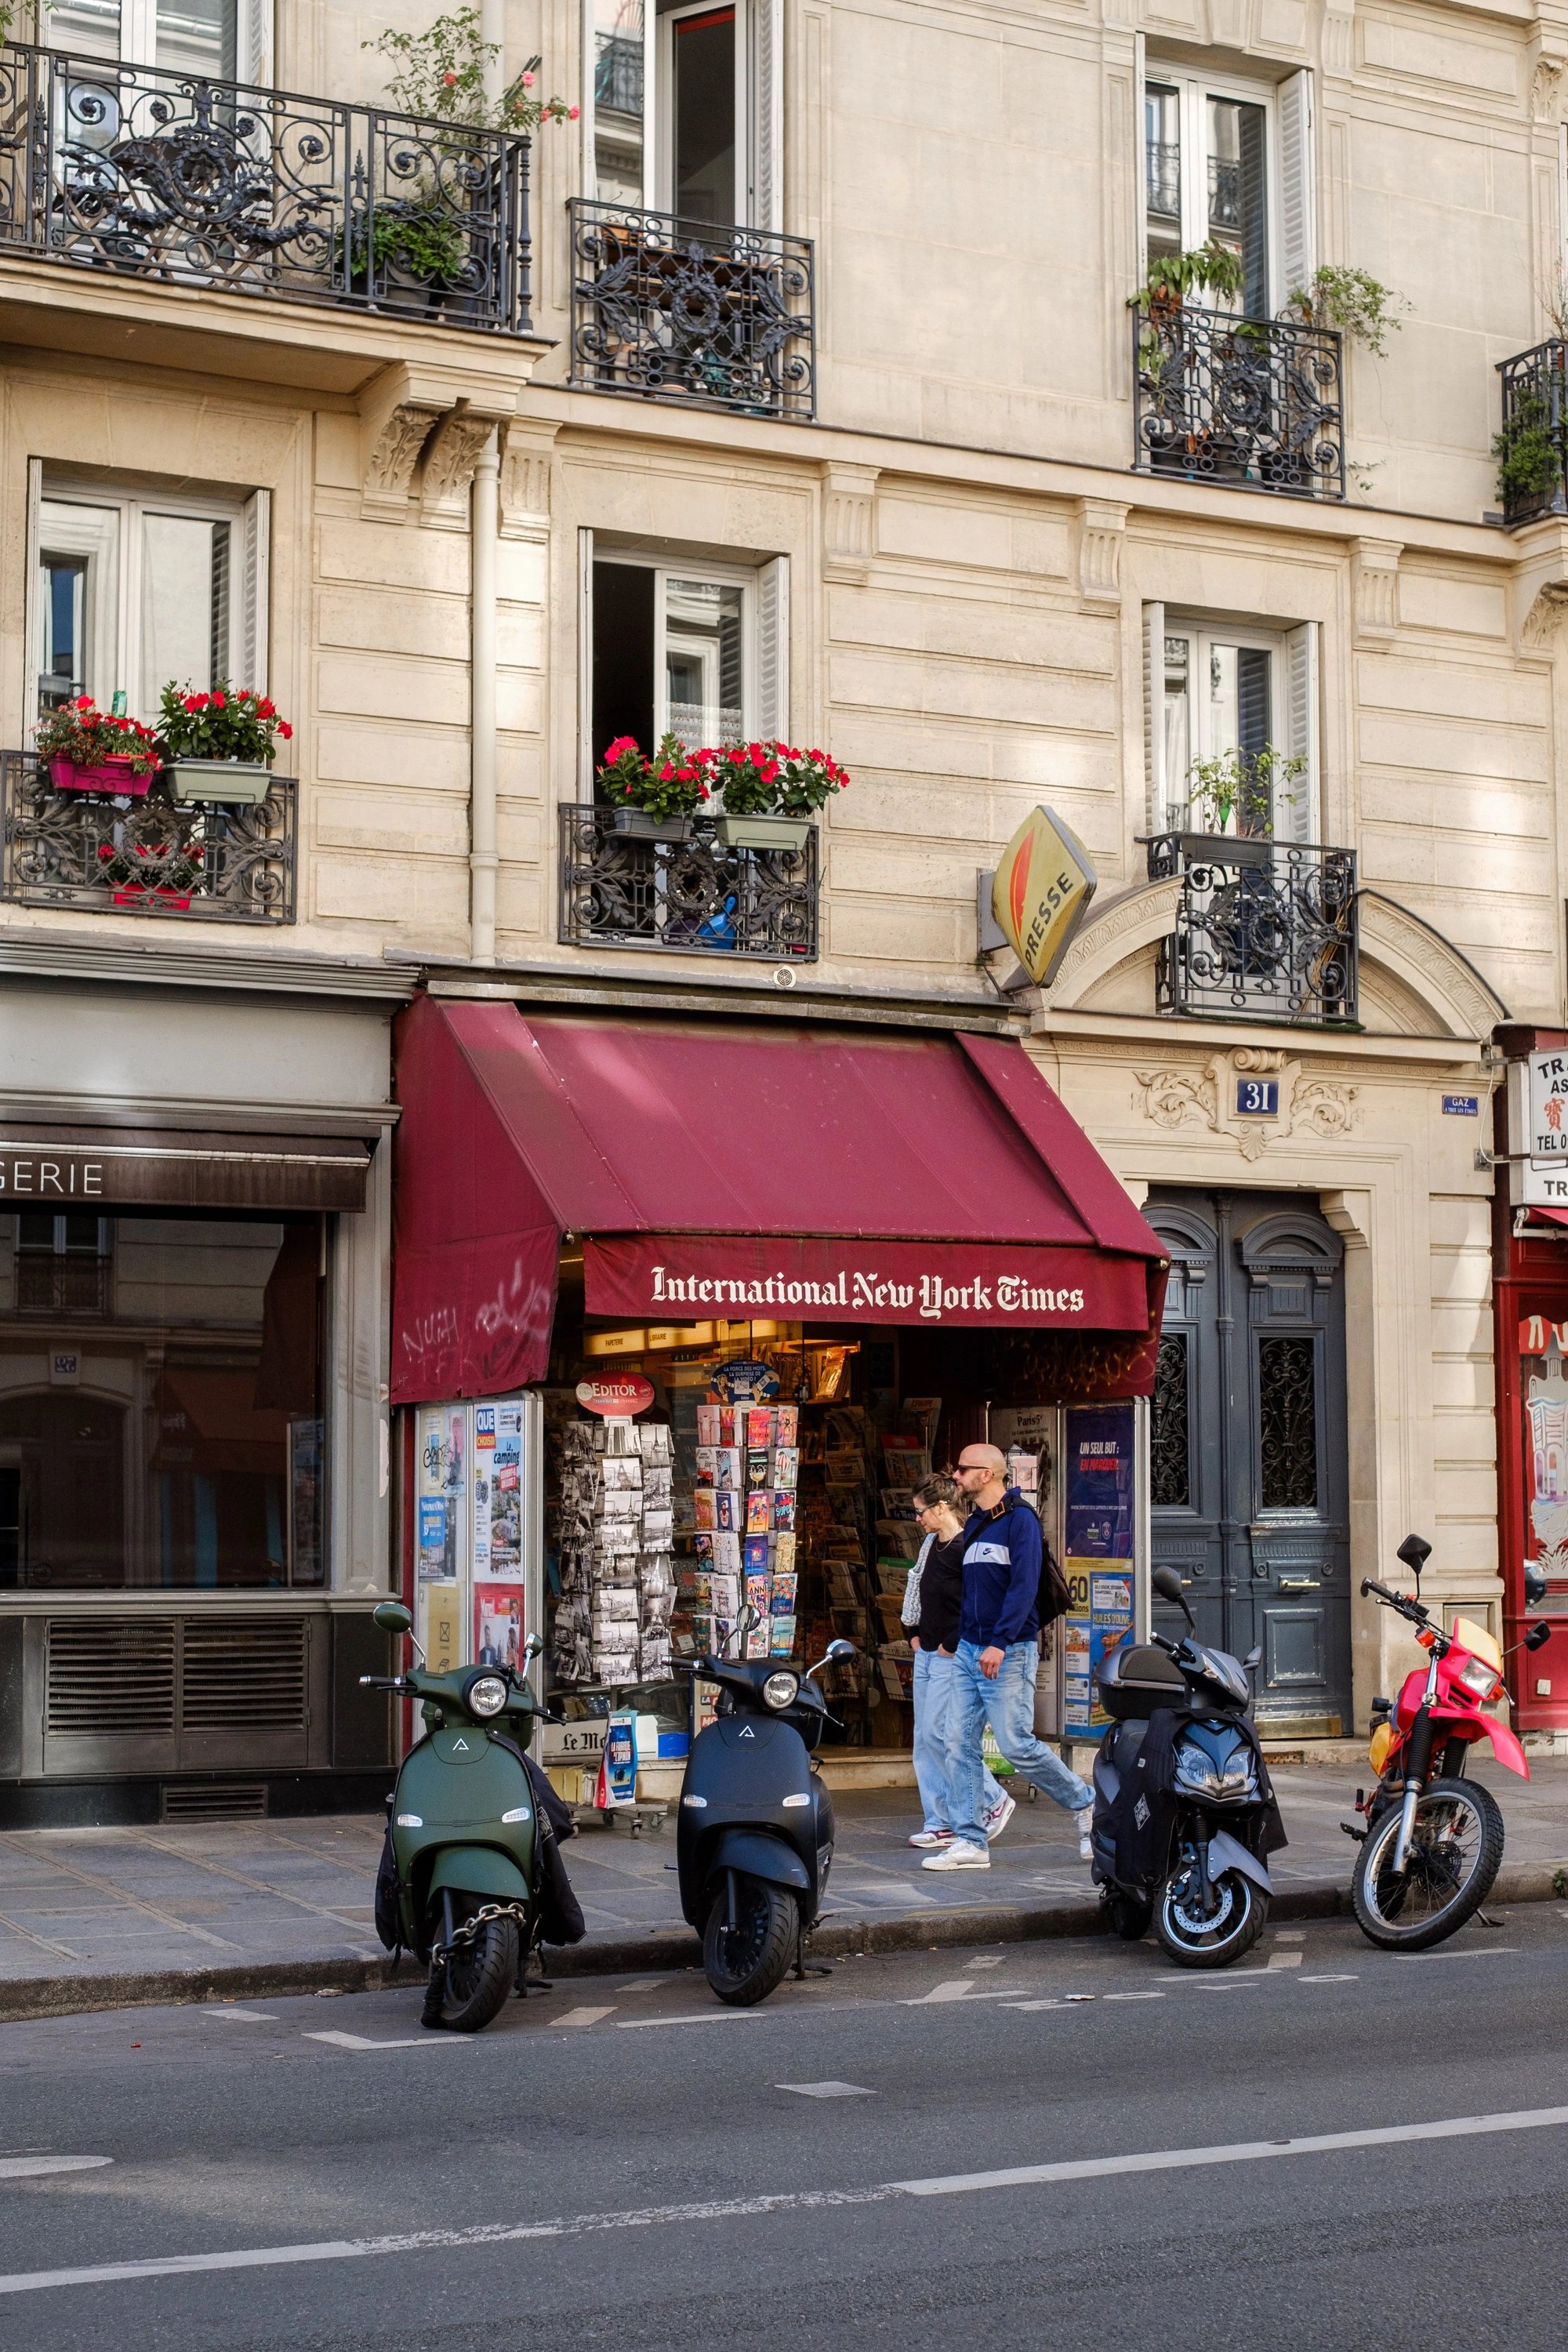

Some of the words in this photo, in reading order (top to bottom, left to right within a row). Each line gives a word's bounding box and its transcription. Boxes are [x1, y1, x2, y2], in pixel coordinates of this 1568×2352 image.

[1025, 872, 1073, 970] PRESSE
[1537, 1058, 1568, 1079] TR
[1247, 1083, 1269, 1110] 31
[1452, 1098, 1469, 1107] GAZ
[1537, 1135, 1557, 1150] TEL
[0, 1161, 102, 1194] ERIE
[651, 1266, 849, 1305] International
[852, 1272, 915, 1310] New
[919, 1275, 994, 1319] York
[996, 1275, 1084, 1312] Times
[605, 1338, 624, 1347] PAPETERIE
[591, 1383, 637, 1396] EDITOR
[477, 1411, 495, 1431] QUE
[477, 1436, 495, 1446] CHOISIR
[506, 1441, 512, 1451] Le
[1080, 1443, 1089, 1454] UN
[1090, 1443, 1103, 1454] SEUL
[1105, 1442, 1117, 1454] BUT
[494, 1449, 520, 1467] camping
[1069, 1576, 1088, 1602] 60
[1093, 1613, 1111, 1624] HUILES
[561, 1733, 578, 1751] Le
